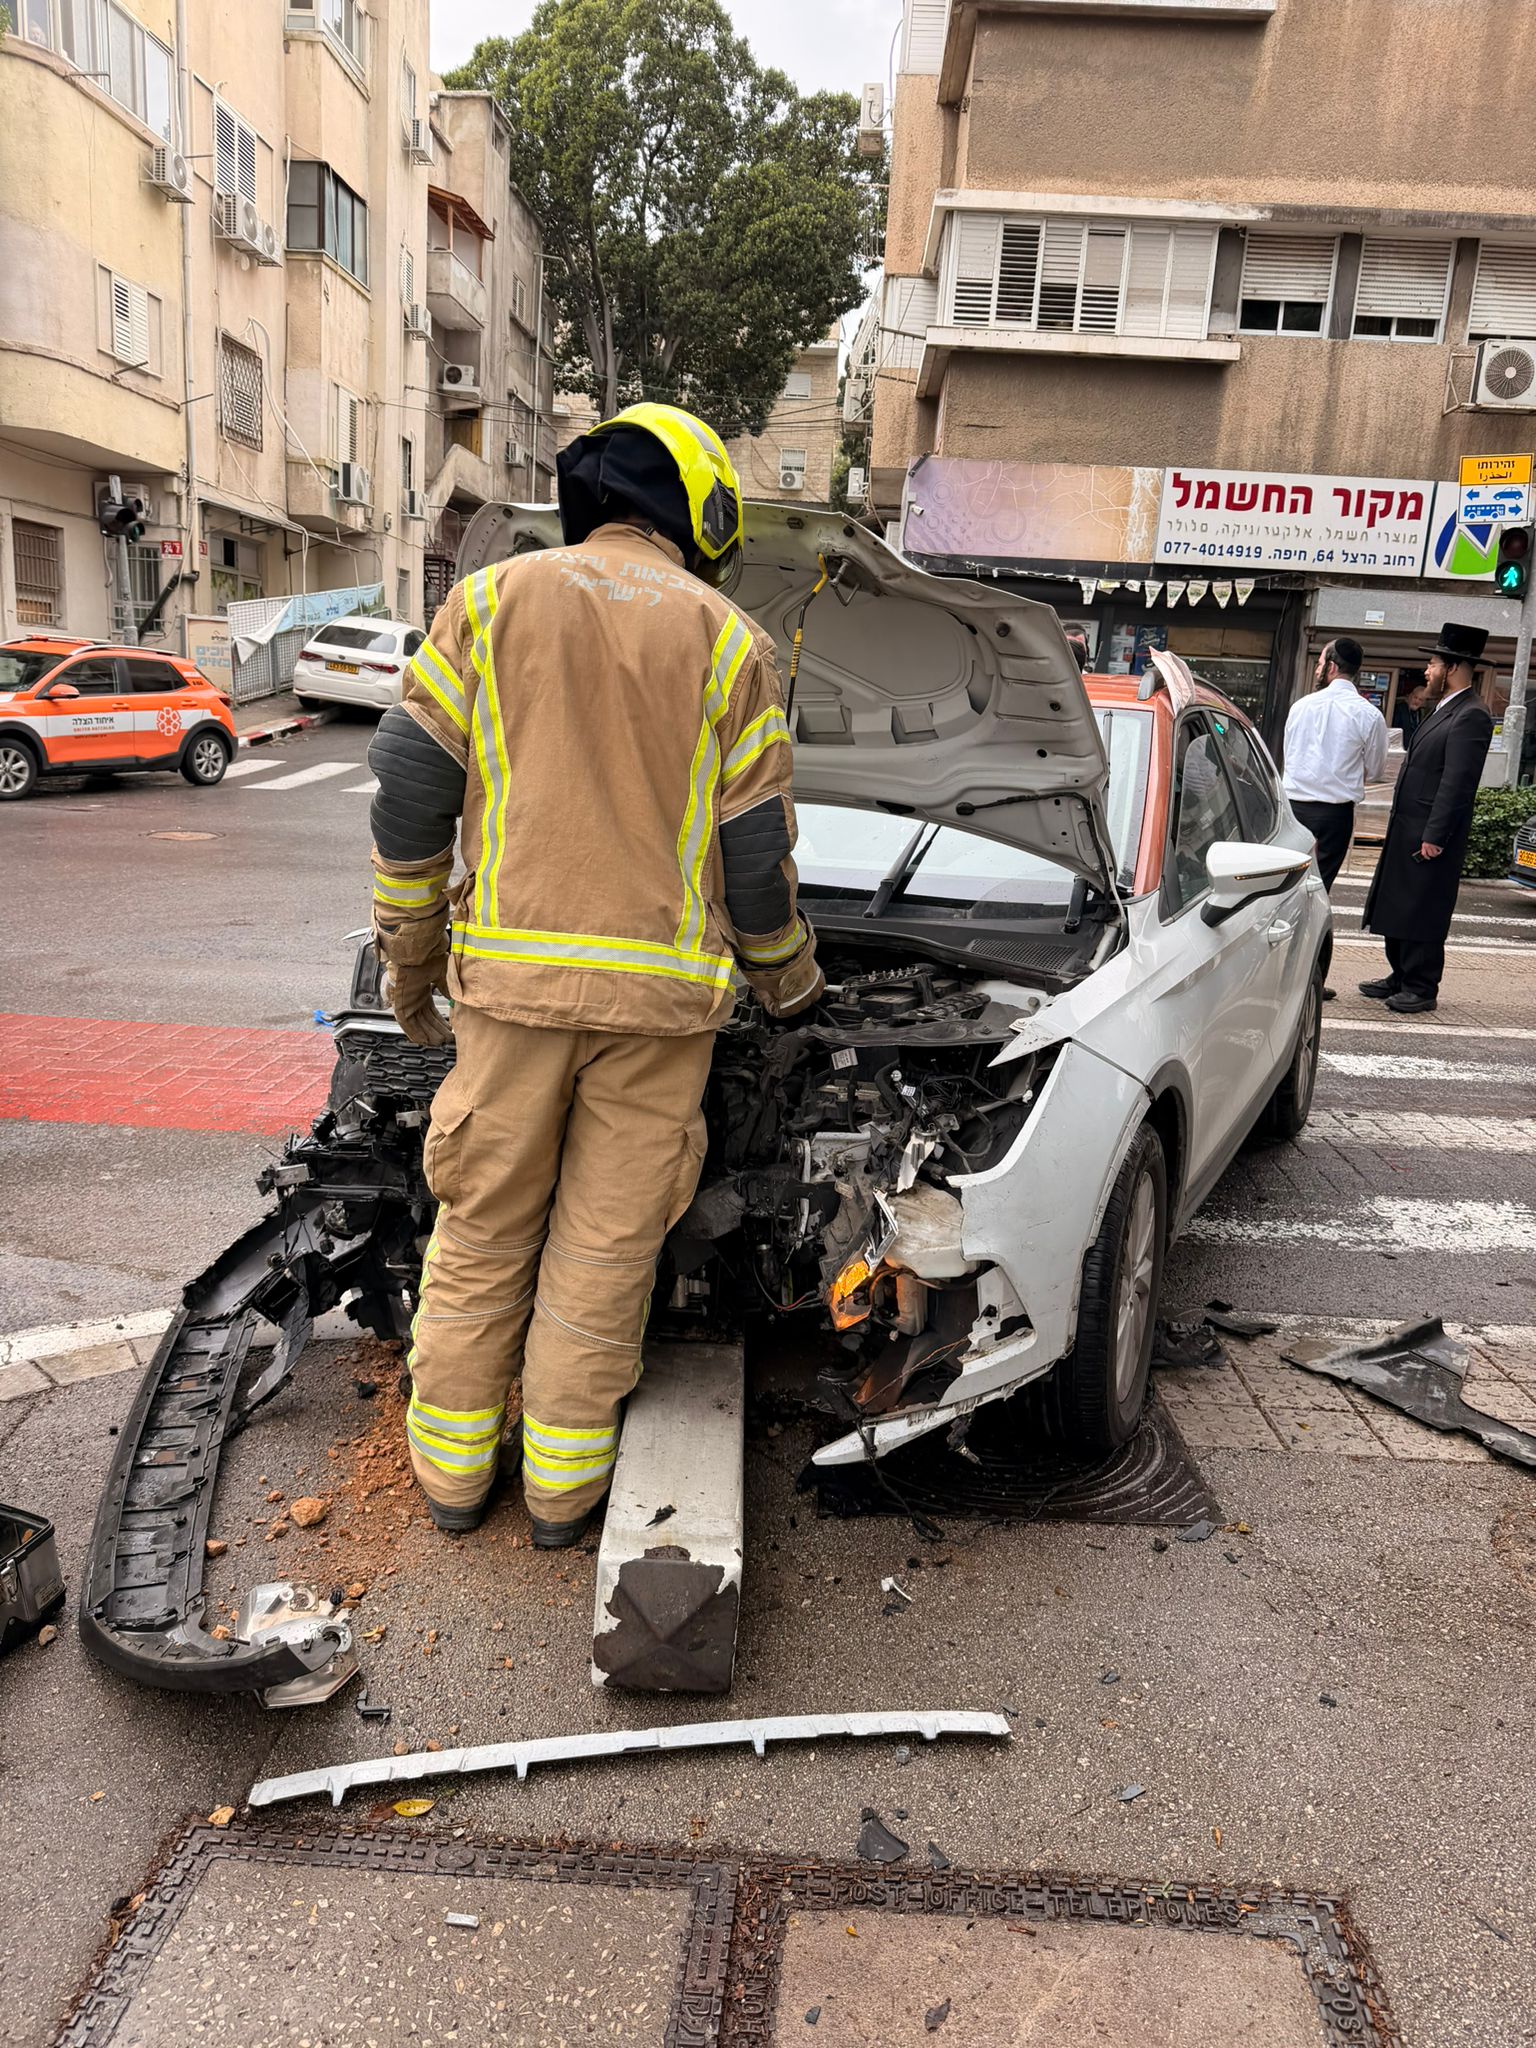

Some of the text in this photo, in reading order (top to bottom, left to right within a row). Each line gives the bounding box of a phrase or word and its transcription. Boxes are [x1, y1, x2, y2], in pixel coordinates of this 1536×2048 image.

[1171, 472, 1425, 528] מקור החשמל
[1163, 541, 1263, 559] 077-4014919
[1342, 549, 1378, 566] הרצל
[1383, 552, 1416, 567] רחוב
[71, 716, 115, 726] איחוד הצלה
